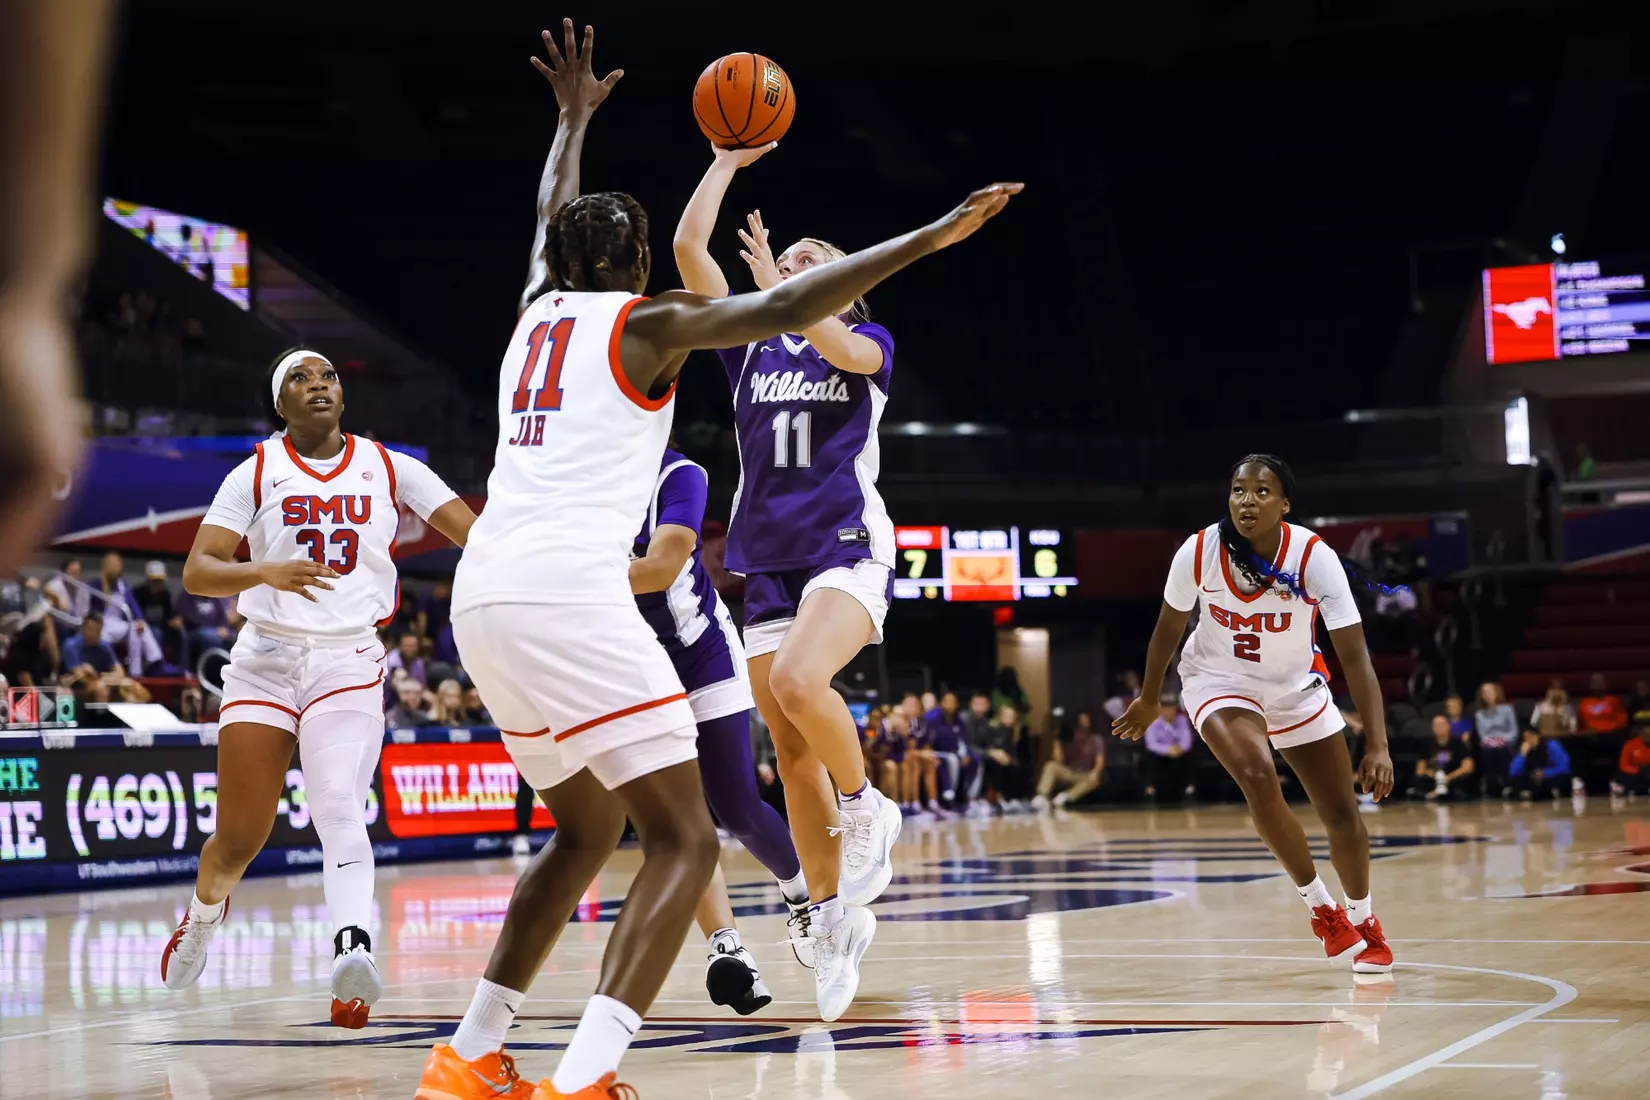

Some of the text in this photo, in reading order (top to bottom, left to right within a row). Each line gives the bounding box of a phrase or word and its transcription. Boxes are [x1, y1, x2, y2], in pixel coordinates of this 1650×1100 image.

[511, 317, 576, 414] 11
[751, 371, 849, 404] Wildcats
[772, 411, 811, 467] 11
[282, 495, 372, 526] SMU
[296, 529, 359, 575] 33
[904, 550, 927, 578] 7
[1035, 549, 1057, 577] 6
[1208, 603, 1292, 633] SMU
[1233, 633, 1261, 663] 2
[66, 771, 188, 856] (469)
